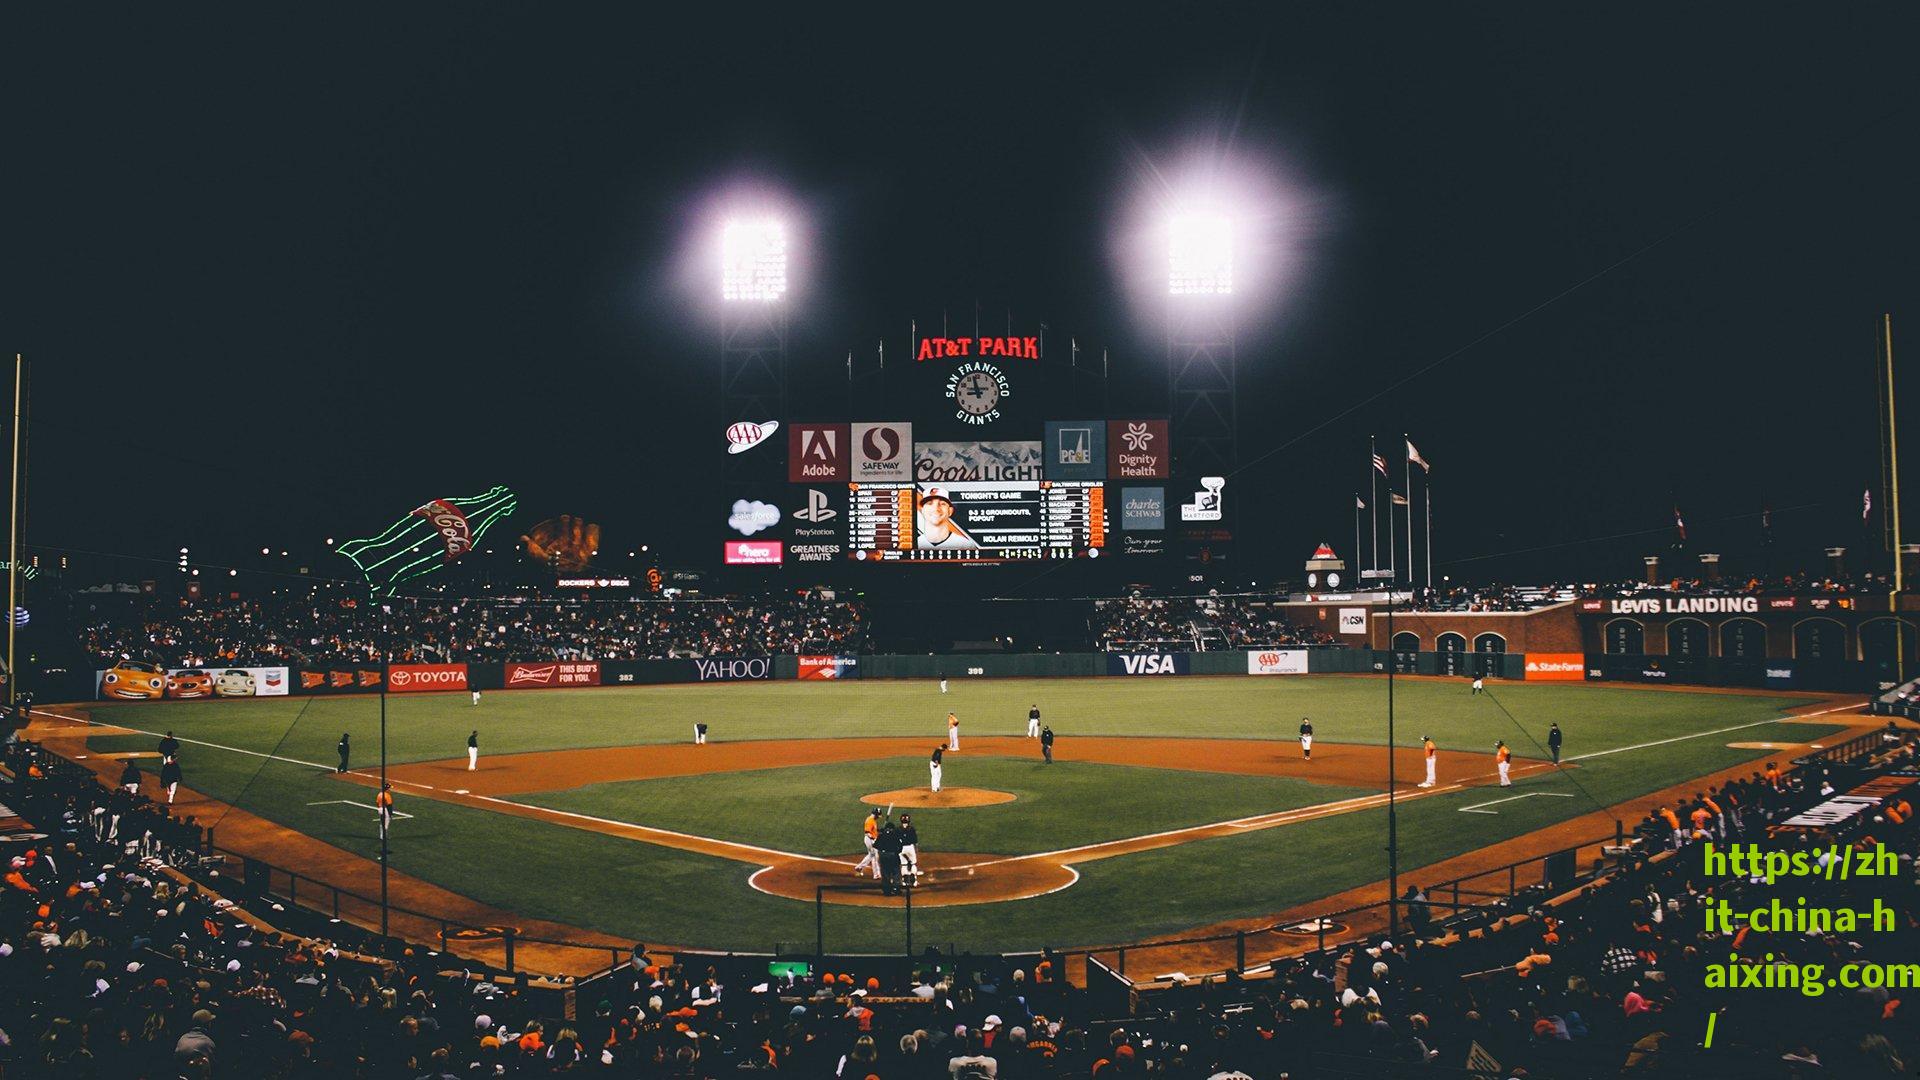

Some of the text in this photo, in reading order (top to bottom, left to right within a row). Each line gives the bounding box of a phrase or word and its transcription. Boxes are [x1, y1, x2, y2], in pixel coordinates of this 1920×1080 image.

[917, 337, 1038, 360] AT&T PARK
[945, 362, 1010, 398] SAN FRANCISCO
[956, 409, 1000, 425] GIANTS
[728, 422, 762, 444] AAA
[1061, 449, 1089, 462] PG&E
[1119, 454, 1157, 466] Dignity
[802, 464, 835, 476] Adobe
[862, 462, 899, 470] SAFEWAY
[916, 458, 1042, 481] Coors LIGHT
[1121, 467, 1155, 476] Health
[960, 492, 998, 500] TONIGHT'S
[1125, 499, 1160, 510] charles
[1125, 510, 1161, 518] SCHWAB
[795, 529, 834, 538] PlayStation
[790, 545, 840, 554] GREATNESS
[798, 553, 832, 561] AWAITS
[1666, 597, 1758, 613] LANDING
[1350, 616, 1364, 624] CSN
[800, 658, 856, 666] Bank of America
[1118, 654, 1175, 674] VISA
[1259, 653, 1279, 666] AAA
[516, 669, 551, 680] Budweiser
[560, 665, 598, 674] THIS BUD'S
[696, 658, 770, 680] YAHOO!
[413, 670, 466, 683] TOYOTA
[560, 674, 590, 682] FOR YOU.
[619, 674, 634, 682] 382
